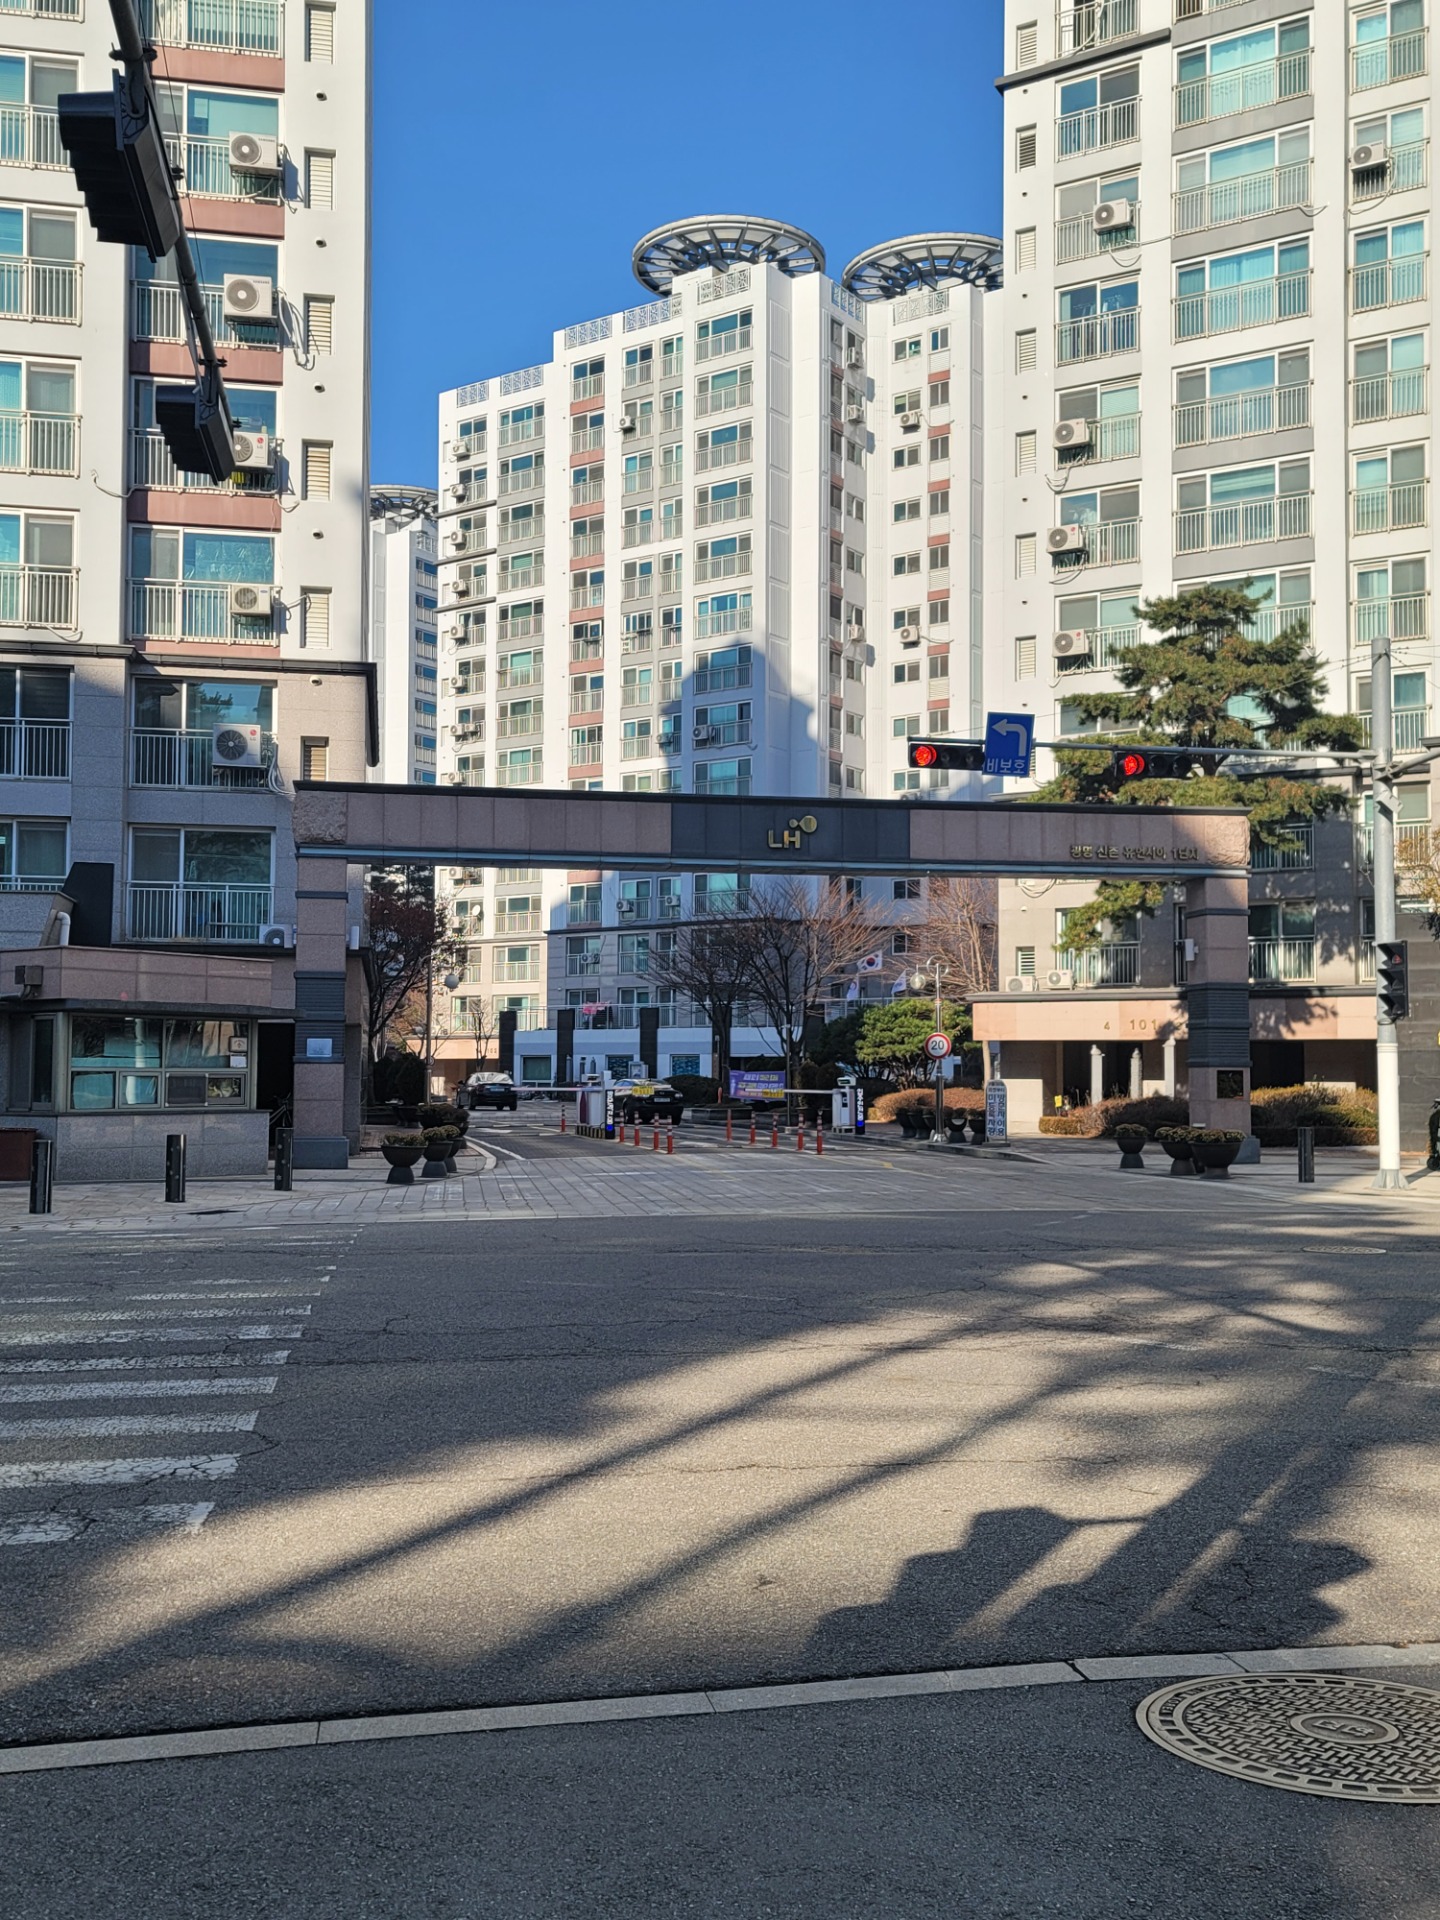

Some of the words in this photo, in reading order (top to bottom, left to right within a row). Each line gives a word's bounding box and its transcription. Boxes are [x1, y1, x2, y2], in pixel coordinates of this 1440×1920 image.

[987, 758, 1025, 774] 비보호
[769, 830, 800, 848] LH
[1071, 845, 1093, 858] 광명
[1104, 1021, 1110, 1030] 4
[1130, 1019, 1157, 1030] 101
[931, 1040, 944, 1050] 20
